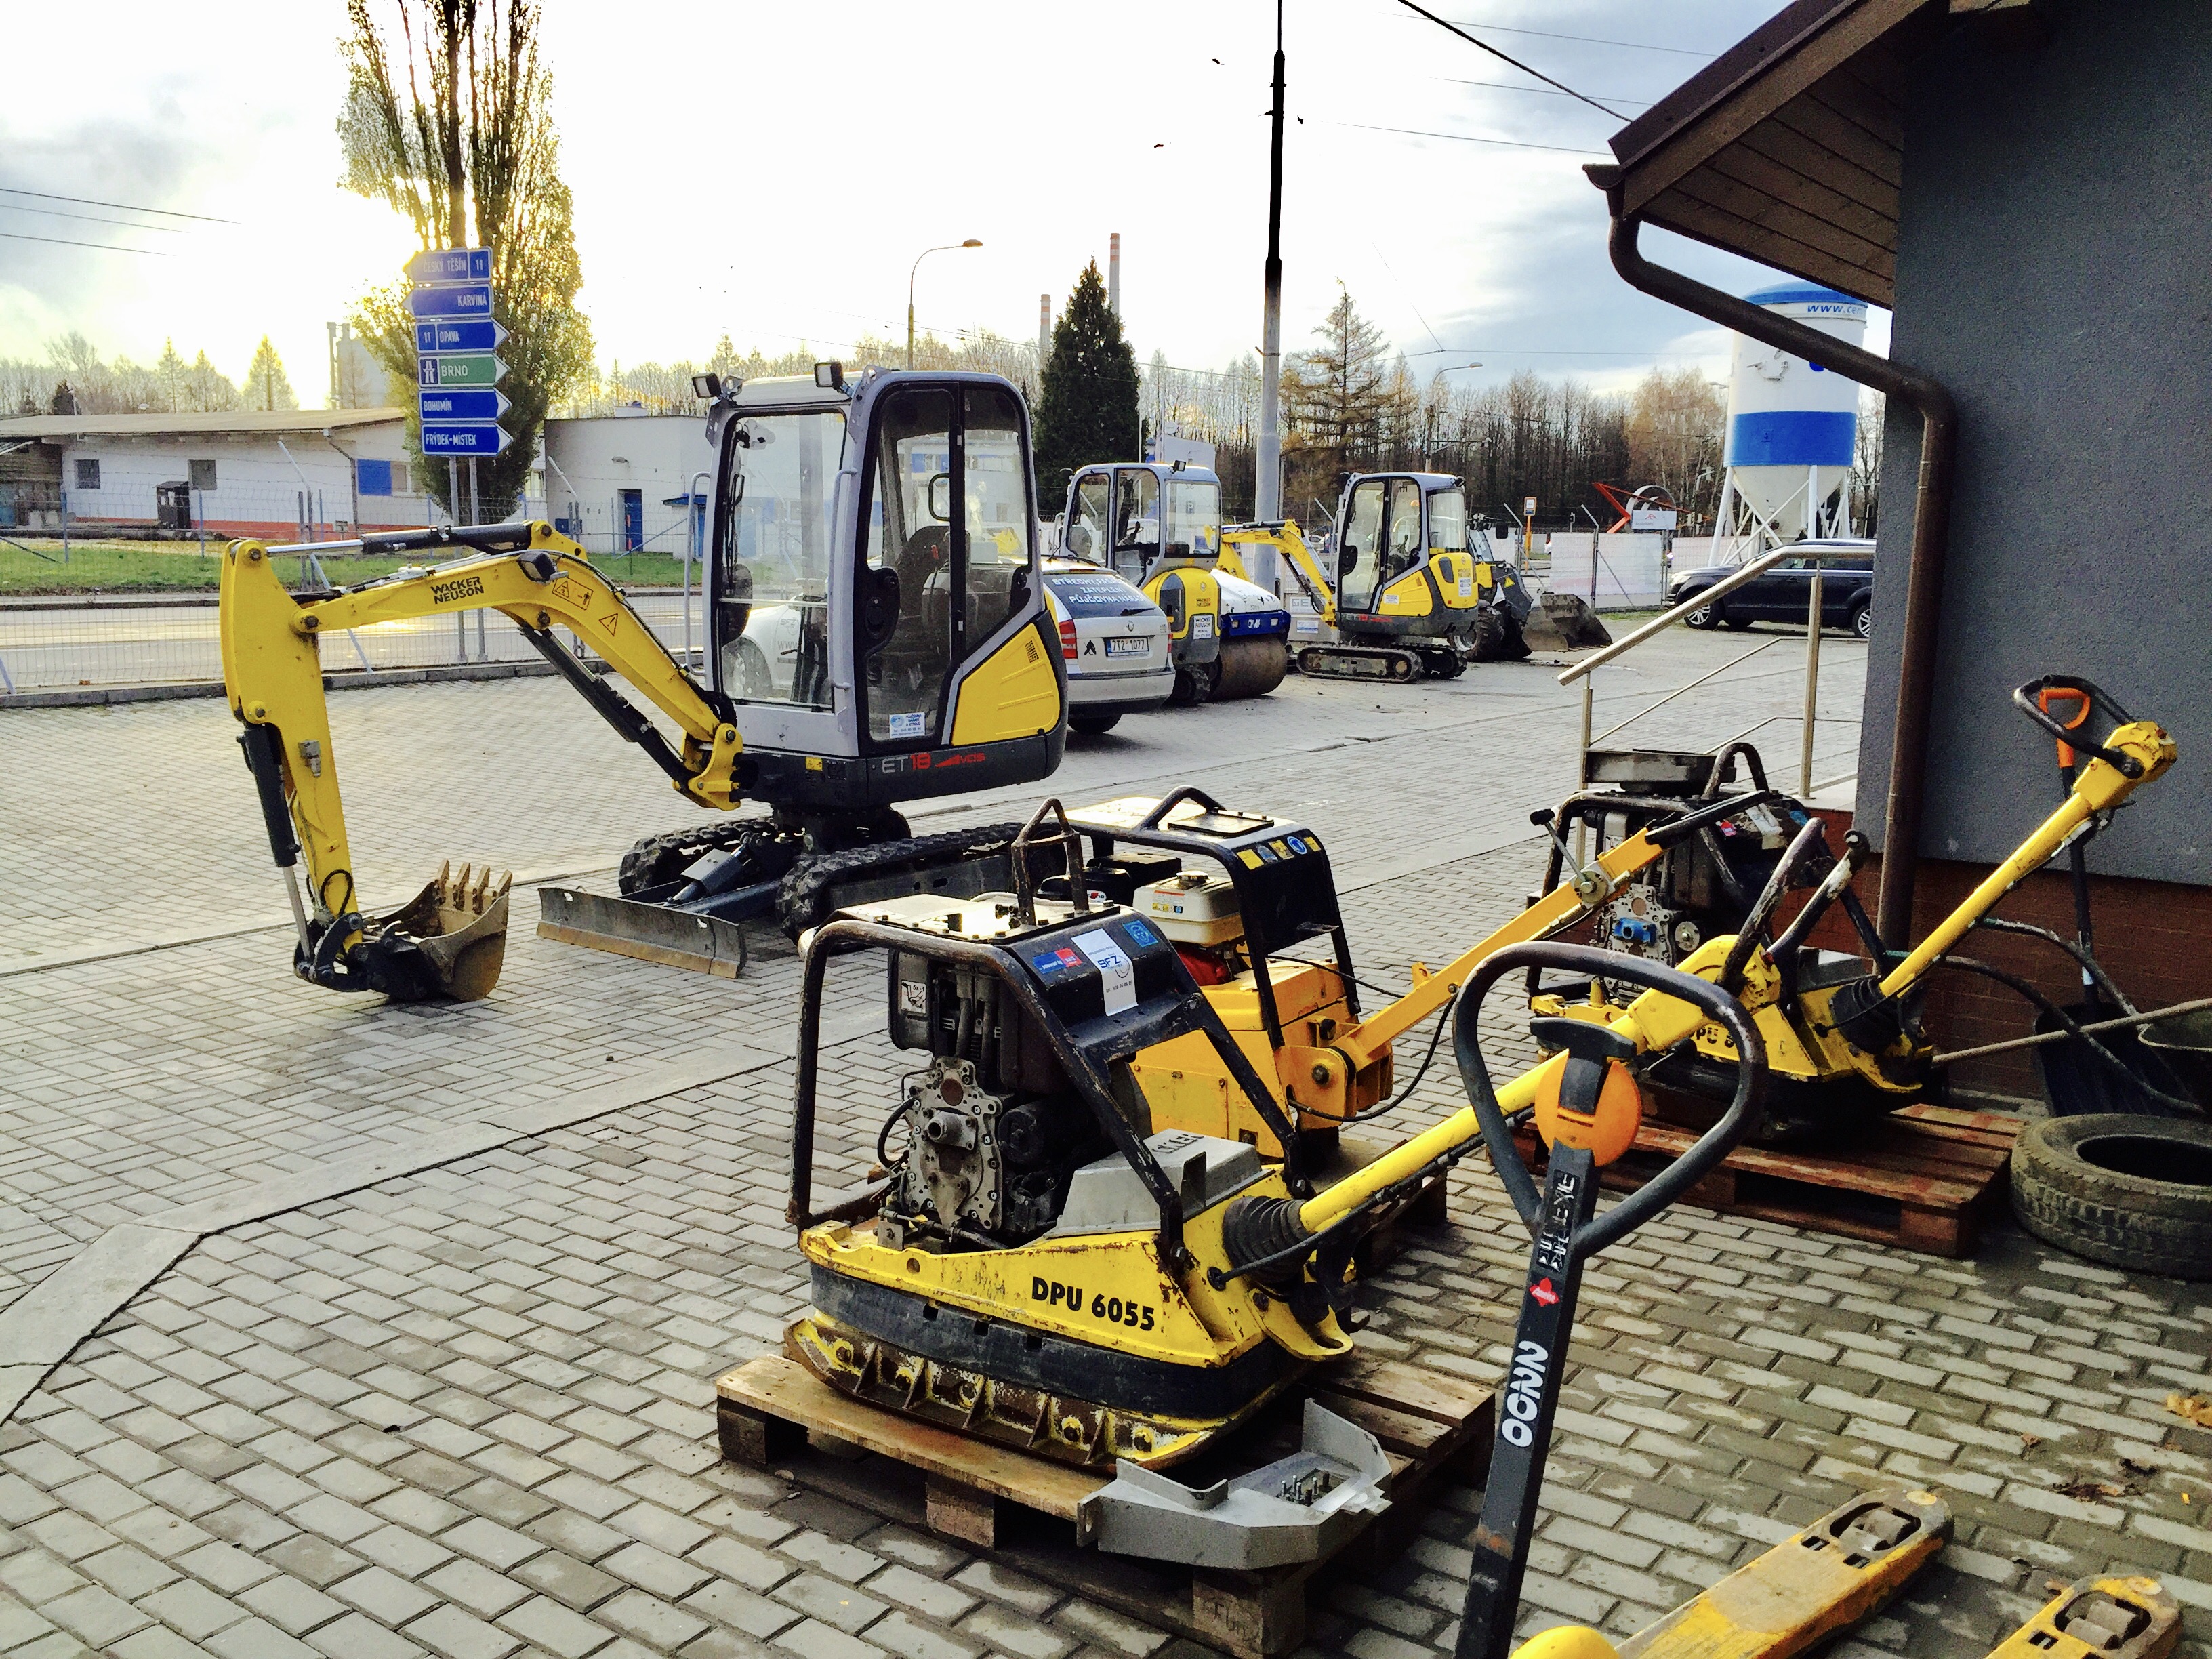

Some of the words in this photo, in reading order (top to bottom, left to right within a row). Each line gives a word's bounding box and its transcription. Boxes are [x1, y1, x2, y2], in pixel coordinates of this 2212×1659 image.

[423, 259, 444, 272] ČESKÝ
[447, 257, 466, 272] TĚŠÍN
[475, 259, 484, 271] 11
[457, 291, 487, 307] KARVINÁ
[423, 331, 432, 344] 11
[439, 330, 461, 344] OPAVA
[441, 365, 469, 377] BRNO
[423, 397, 453, 412] BOHUMÍN
[425, 430, 477, 446] FRÝDEK-MÍSTEK
[430, 576, 482, 594] WACKER
[433, 585, 484, 604] NEUSON
[1068, 594, 1118, 604] PŮJČOVNA
[1112, 640, 1126, 651] 7T2
[1129, 639, 1145, 651] 1077
[882, 752, 932, 774] ET18
[1031, 1276, 1083, 1311] DPU
[1091, 1293, 1155, 1332] 6055
